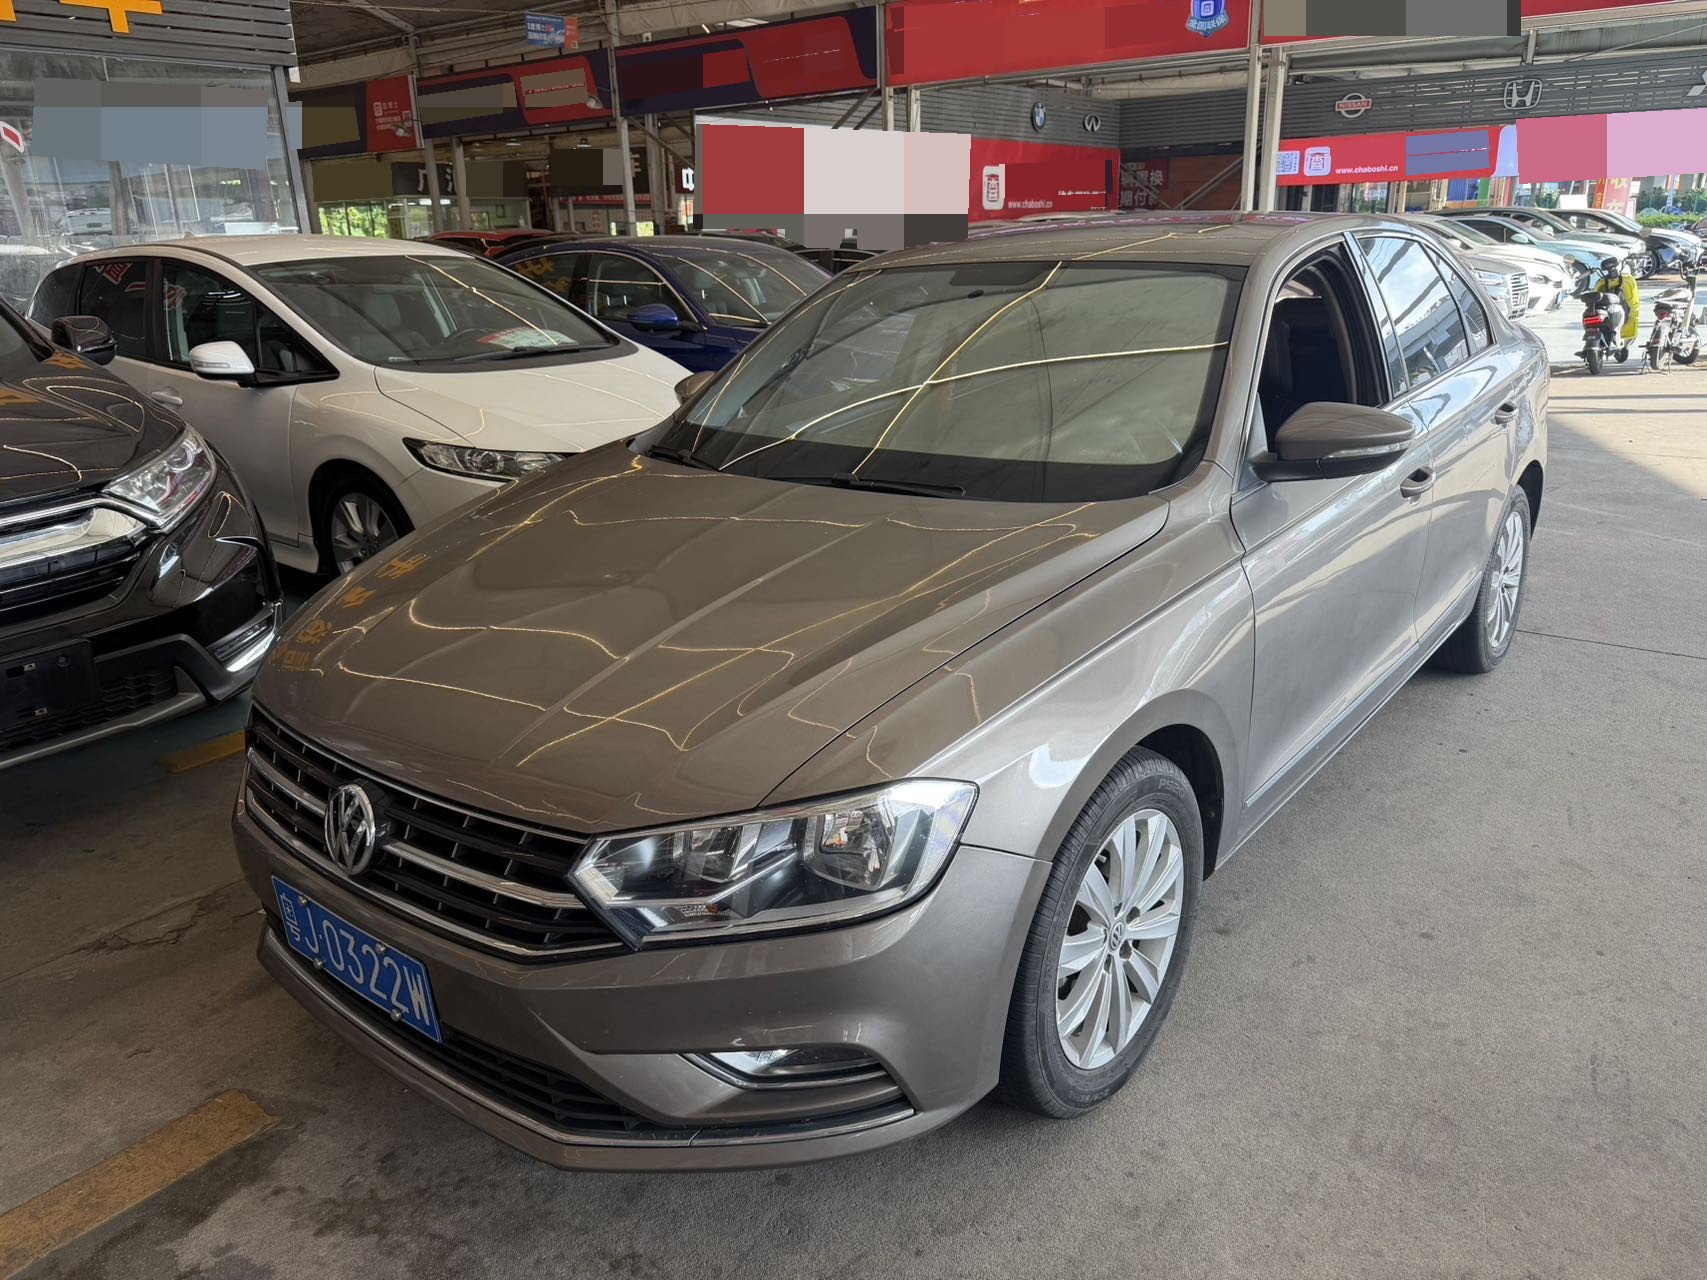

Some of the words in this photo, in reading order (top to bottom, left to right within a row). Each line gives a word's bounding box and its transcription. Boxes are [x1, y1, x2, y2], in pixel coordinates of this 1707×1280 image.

[1337, 100, 1370, 110] NISSAN
[1335, 164, 1398, 174] www.chaboshi.cn
[1008, 200, 1053, 209] www.chaboshi.cn
